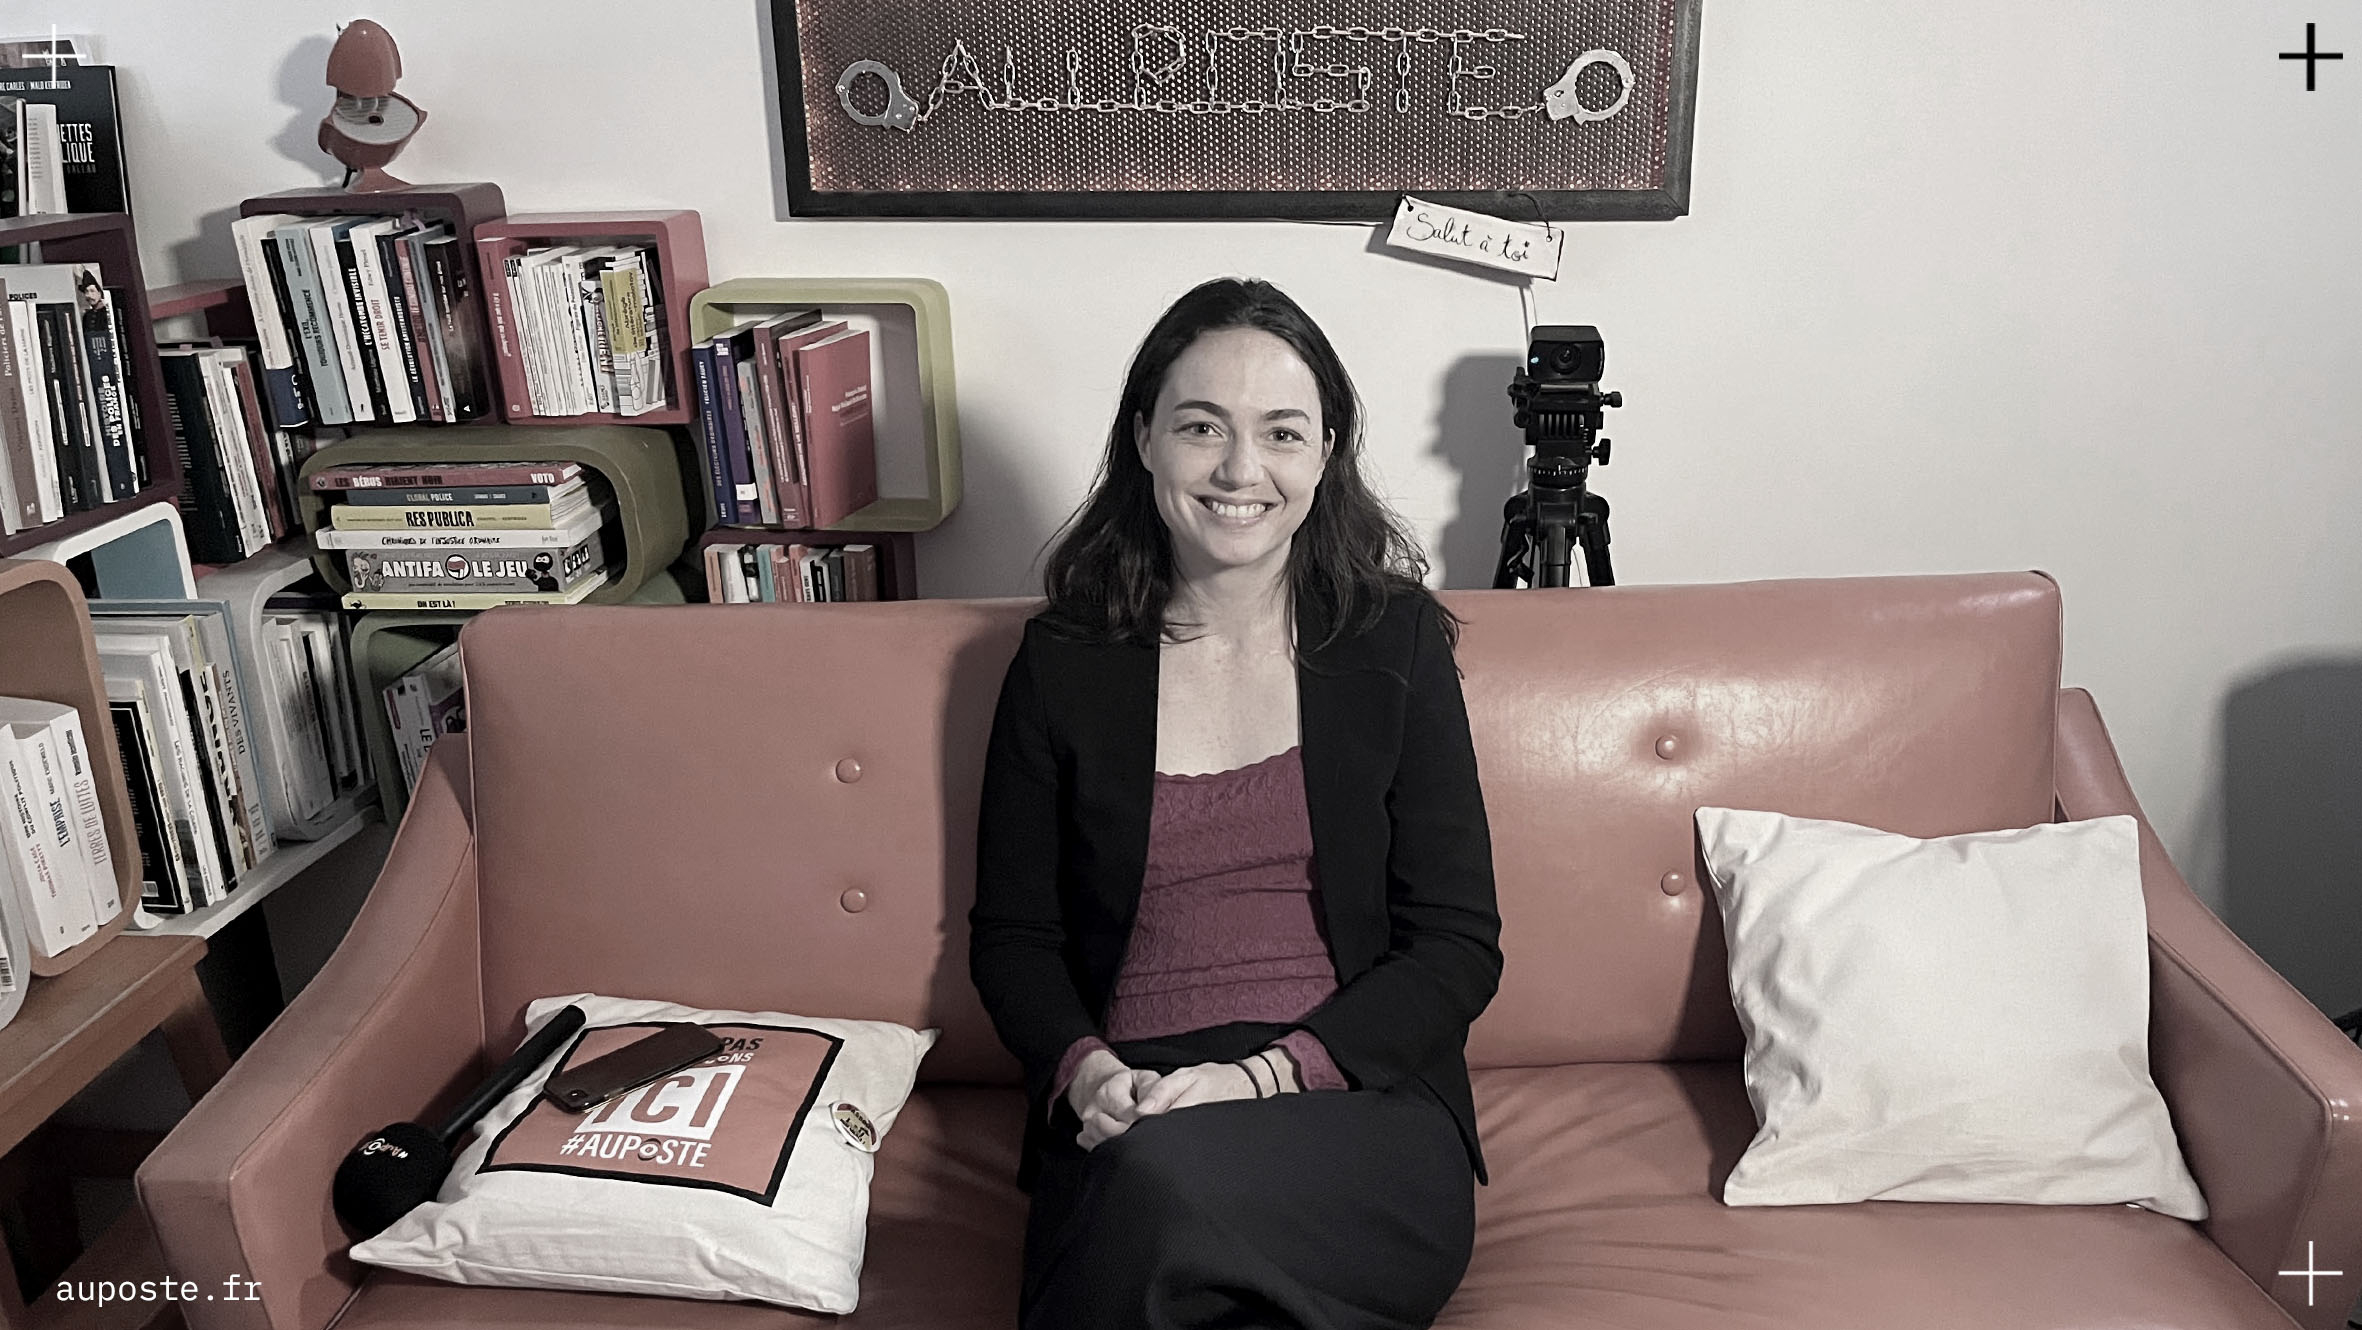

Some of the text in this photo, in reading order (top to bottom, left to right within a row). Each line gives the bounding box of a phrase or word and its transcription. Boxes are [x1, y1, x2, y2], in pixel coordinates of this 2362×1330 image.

[1406, 212, 1531, 262] Salut à toi
[347, 266, 362, 301] INVISIBLE
[9, 292, 38, 300] POLICES
[370, 297, 391, 351] SE TENIR DROIT
[100, 374, 116, 423] POLICES
[109, 425, 120, 447] DES
[353, 475, 382, 488] BÉRUS
[530, 473, 555, 484] VOTO
[430, 493, 454, 502] POLICE
[406, 511, 474, 527] RES PUBLICA
[382, 560, 528, 578] ANTIFA LE JEU
[429, 600, 440, 608] EST
[221, 669, 246, 754] DES VIVANTS
[72, 779, 95, 815] LUTTES
[29, 824, 36, 834] DU
[48, 797, 71, 847] L'EMPRISE
[82, 815, 98, 828] DE
[85, 828, 108, 865] TERRES
[722, 1037, 764, 1052] PAS
[560, 1134, 712, 1168] #AUPOSTE
